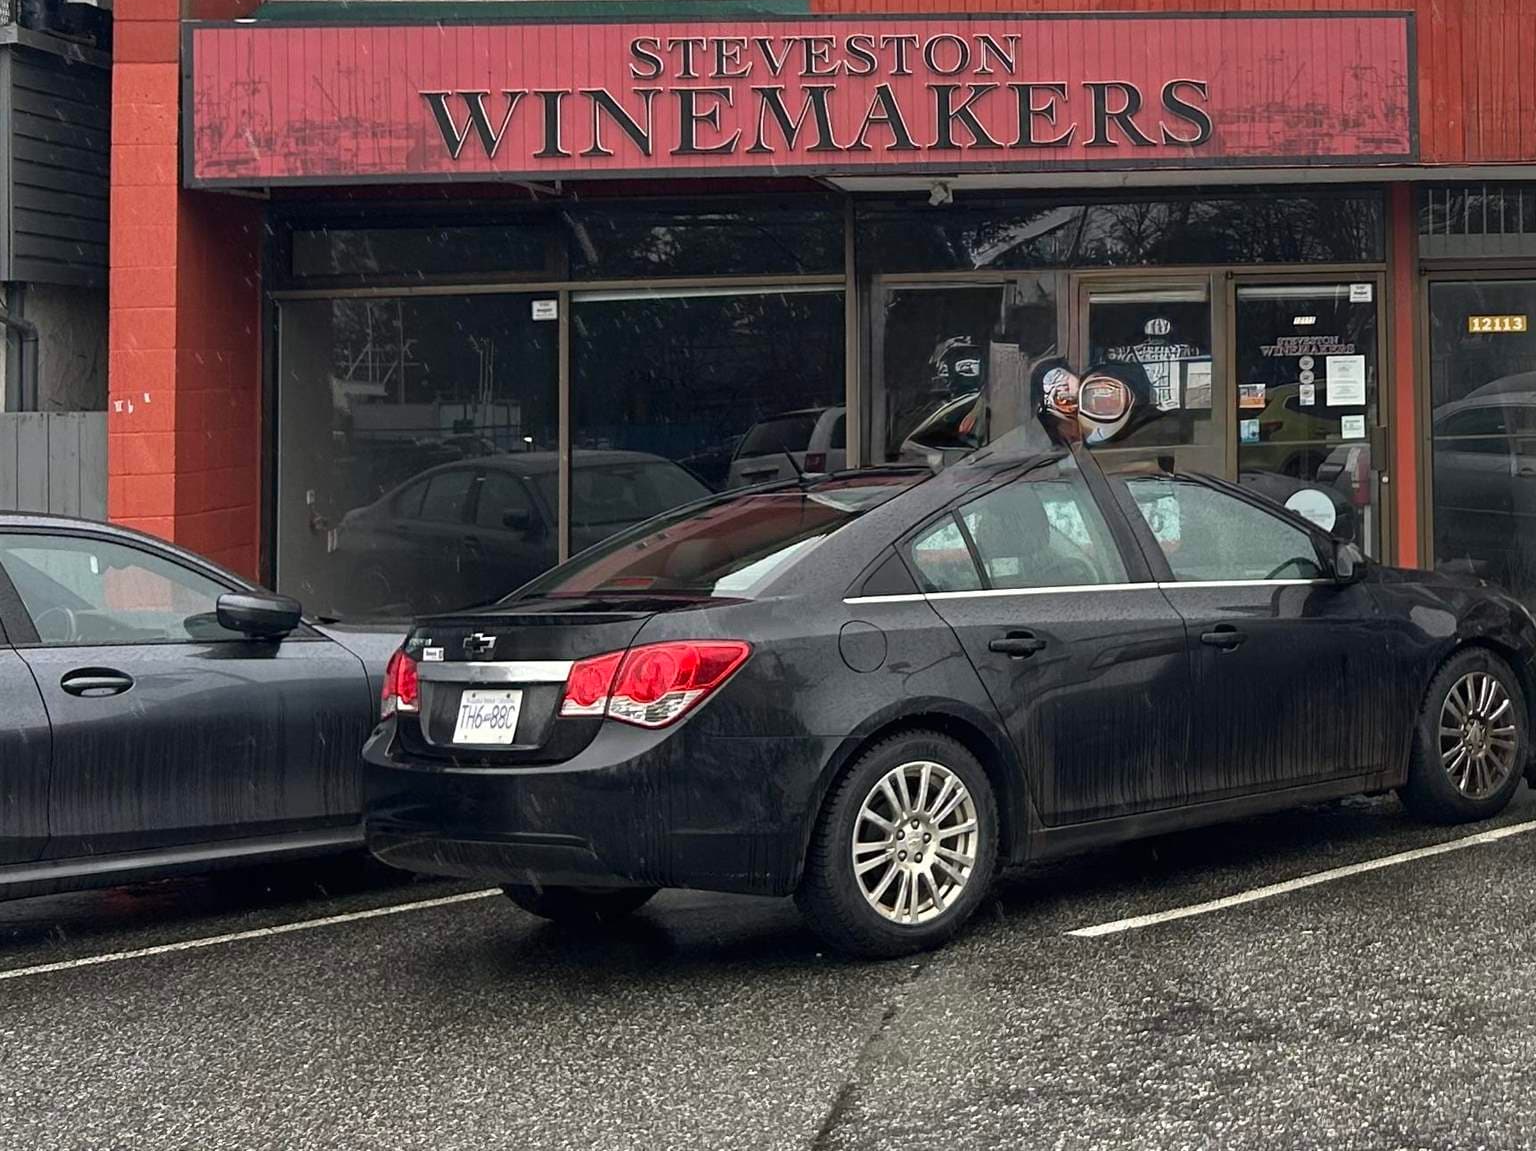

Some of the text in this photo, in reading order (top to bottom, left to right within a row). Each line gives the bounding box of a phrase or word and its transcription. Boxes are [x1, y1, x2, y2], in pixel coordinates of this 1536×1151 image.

[629, 33, 1021, 79] STEVESTON
[418, 78, 1214, 161] WINEMAKERS
[1472, 317, 1523, 331] 12113
[1276, 335, 1339, 347] STEVESTON
[1260, 344, 1356, 357] WINEMAKERS
